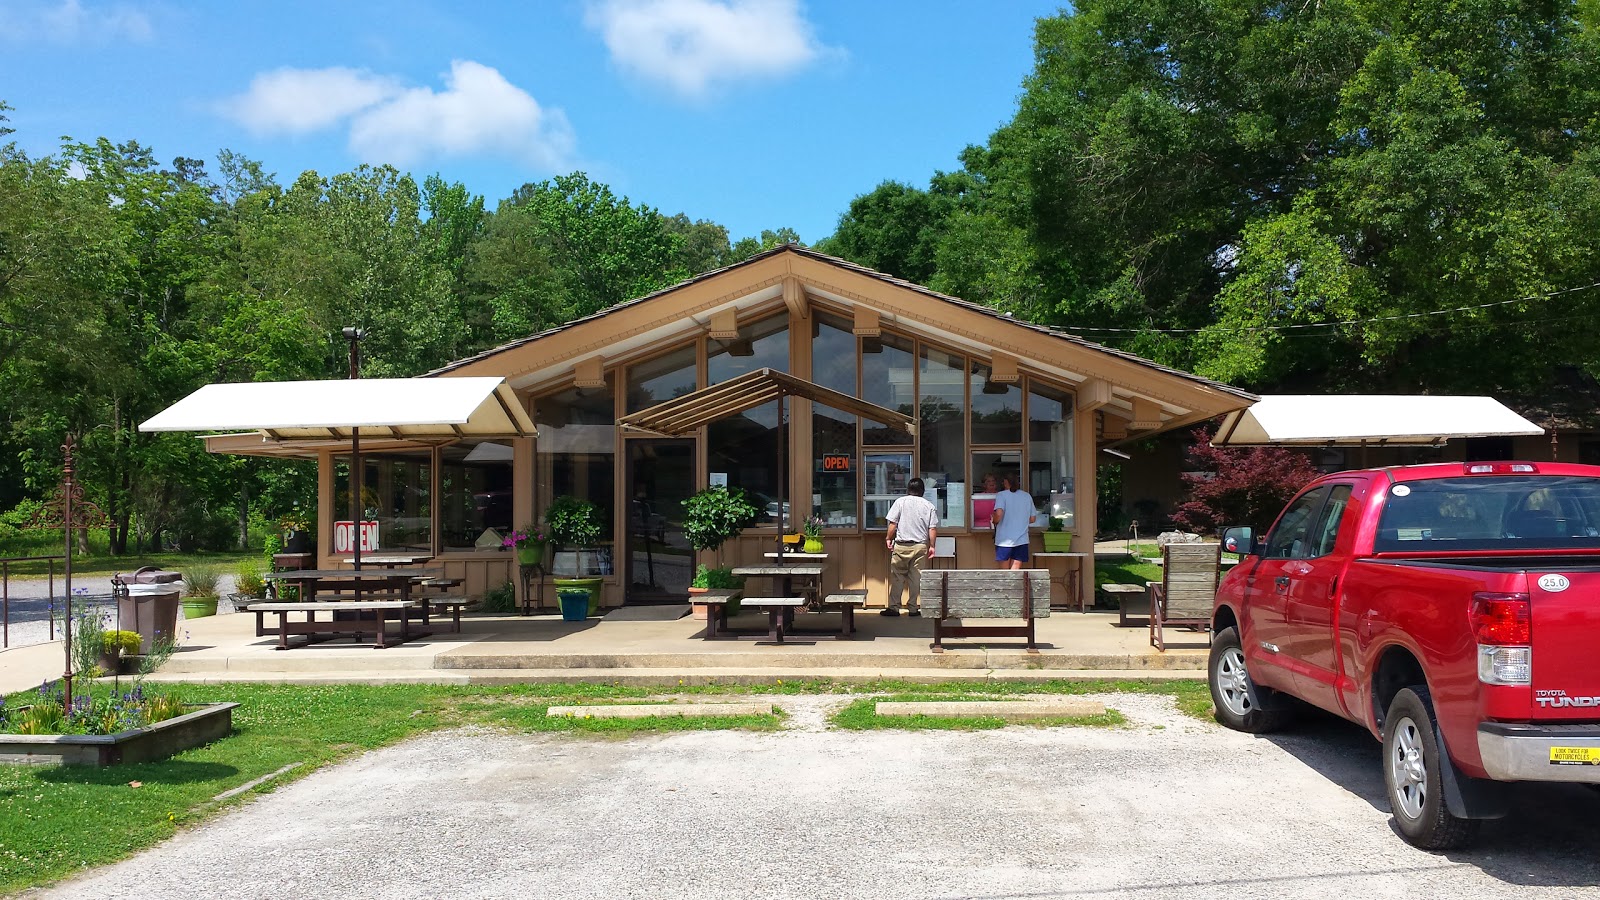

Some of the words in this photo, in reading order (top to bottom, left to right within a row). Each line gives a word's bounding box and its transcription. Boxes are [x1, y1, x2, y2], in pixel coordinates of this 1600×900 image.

[825, 457, 849, 469] OPEN
[337, 525, 377, 551] OPEN
[1543, 578, 1565, 587] 25.0
